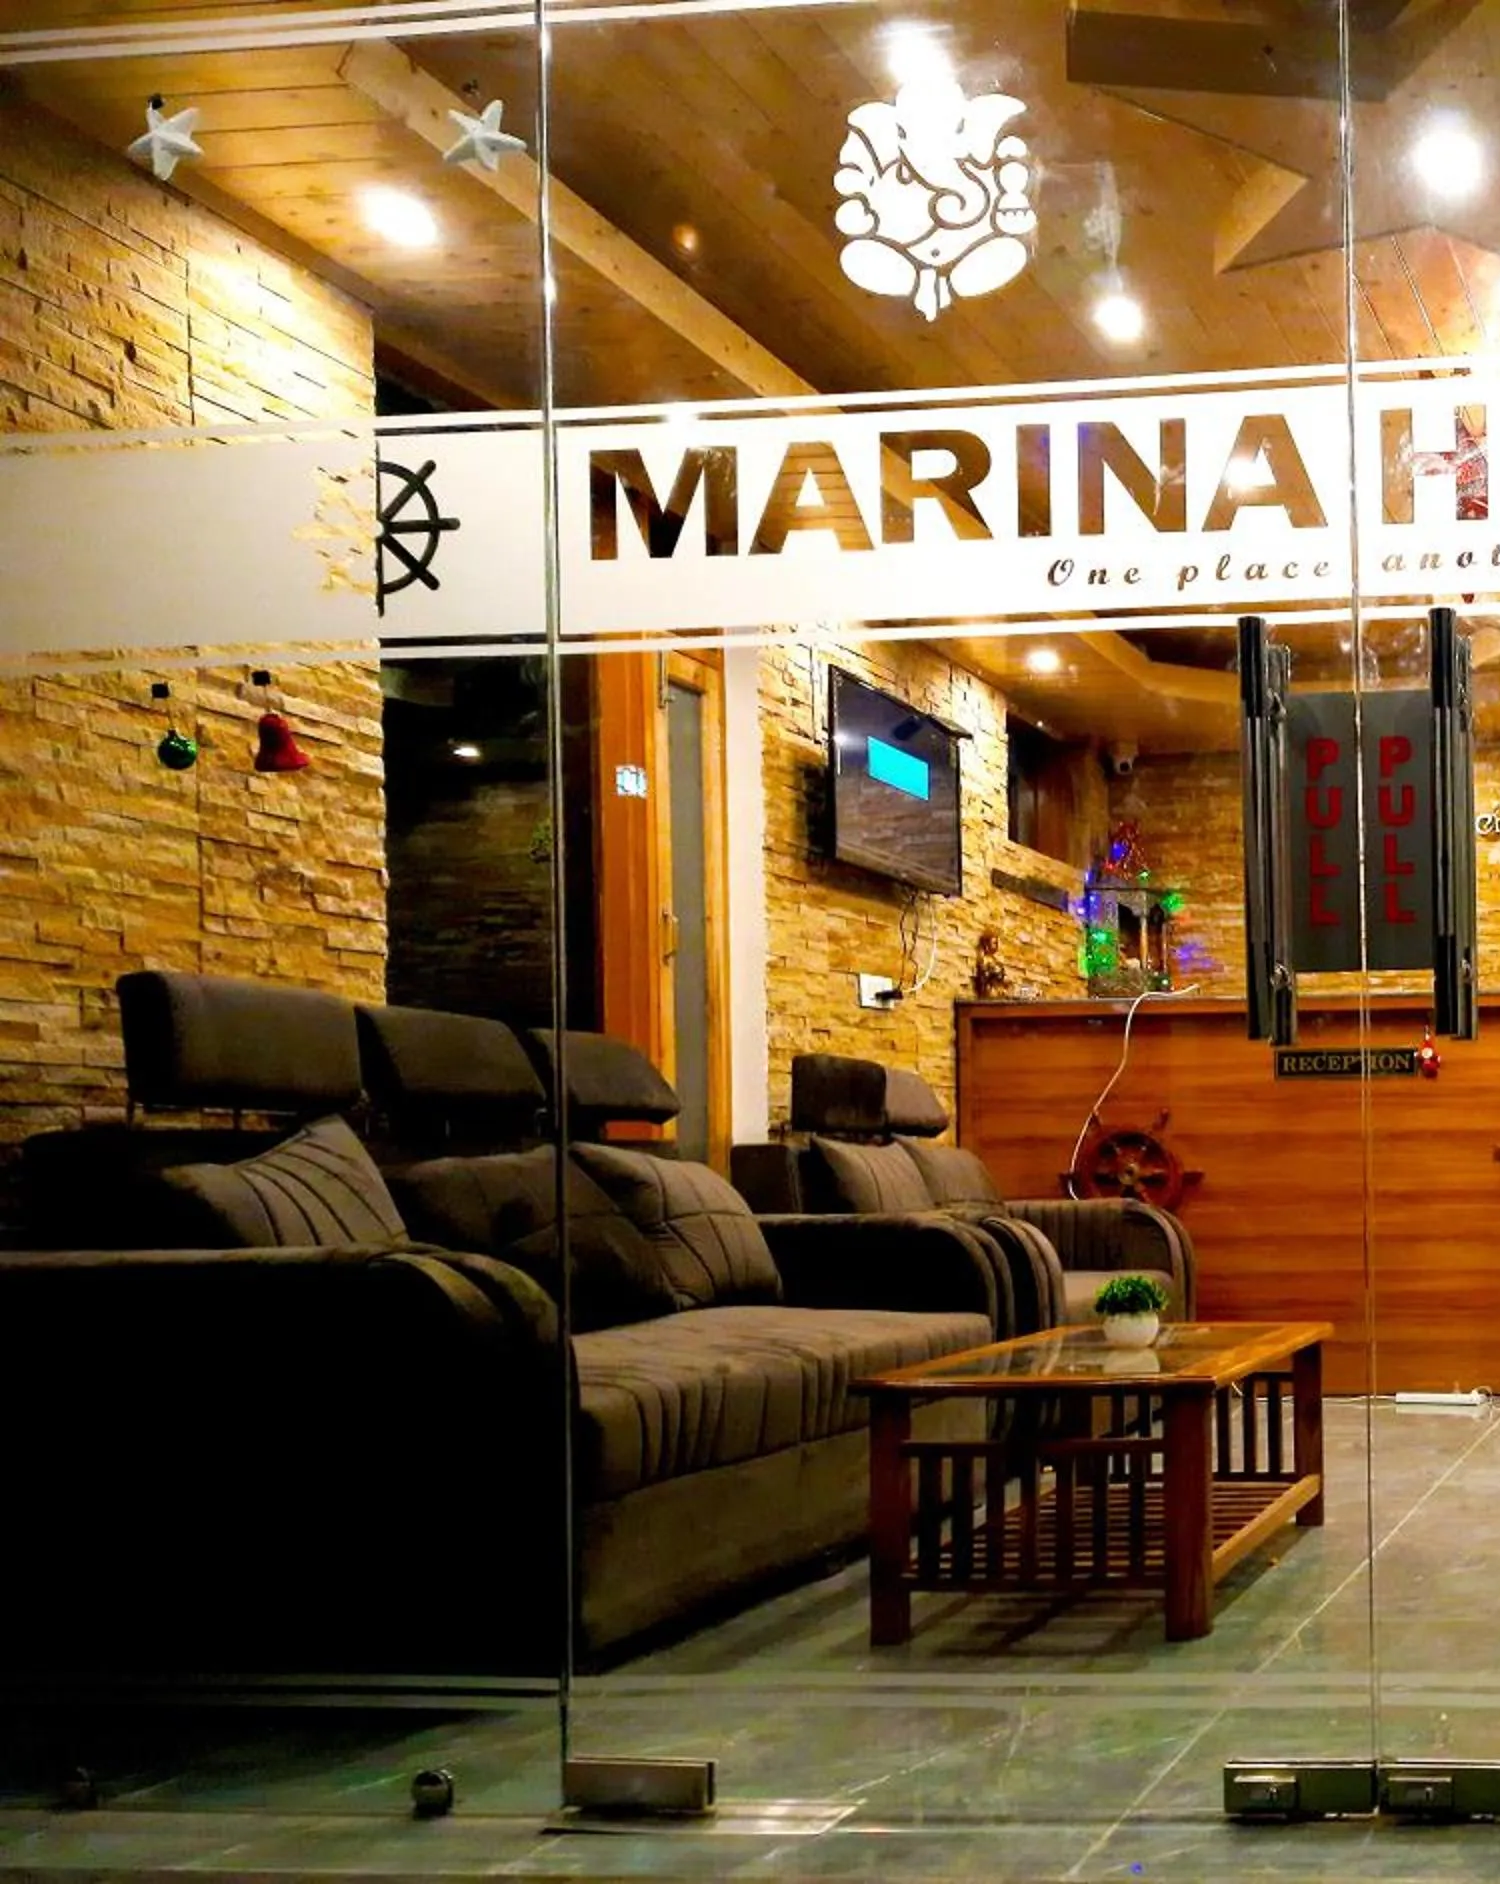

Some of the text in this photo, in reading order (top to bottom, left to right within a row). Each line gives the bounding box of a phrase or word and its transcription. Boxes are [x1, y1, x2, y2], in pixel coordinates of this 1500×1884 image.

[589, 411, 1329, 562] MARINA
[1048, 558, 1142, 587] One
[1176, 554, 1330, 591] place
[1304, 736, 1342, 927] PULL
[1379, 734, 1416, 926] PULL
